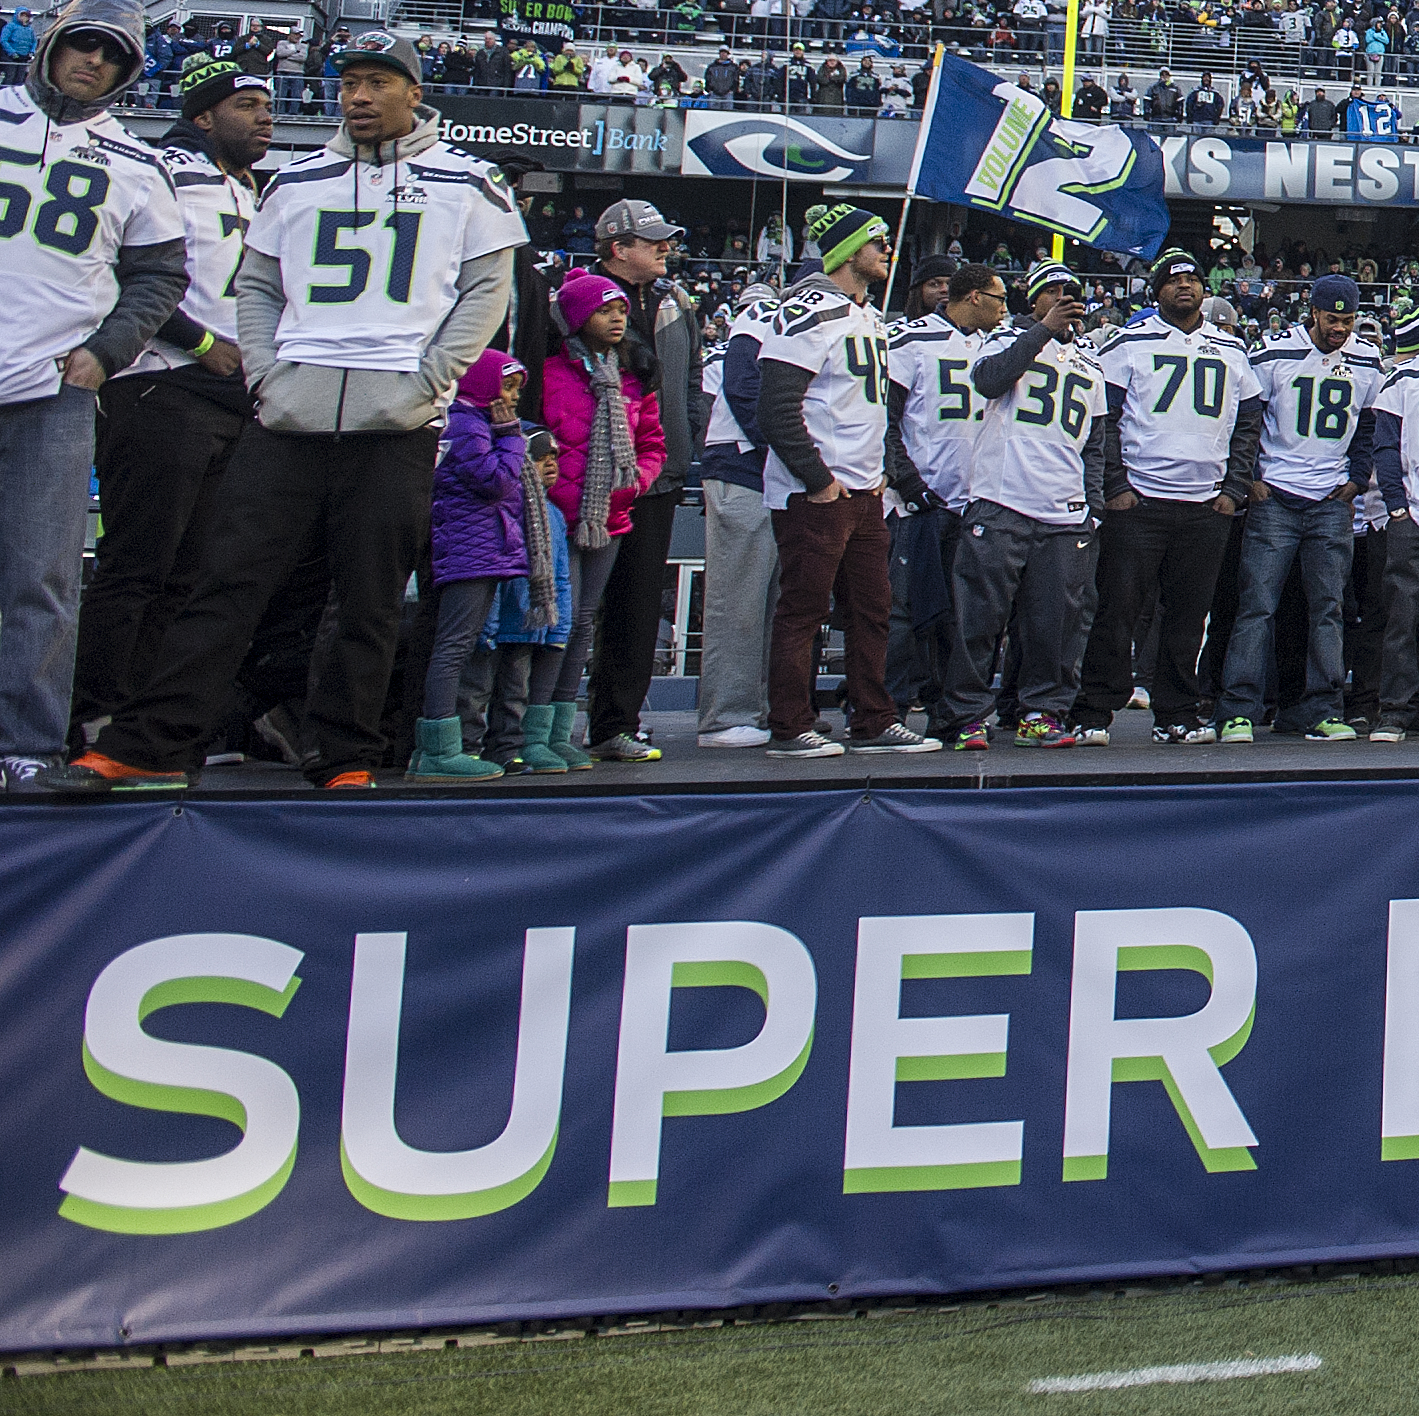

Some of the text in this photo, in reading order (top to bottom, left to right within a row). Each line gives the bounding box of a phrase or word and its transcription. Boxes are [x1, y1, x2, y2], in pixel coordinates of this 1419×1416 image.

[1022, 4, 1038, 15] 25
[213, 44, 233, 58] 12
[607, 128, 669, 153] Bank
[975, 97, 1037, 192] VOLUME
[1357, 103, 1393, 136] 12
[965, 82, 1137, 242] 12
[305, 207, 425, 306] 51
[937, 358, 986, 422] 5
[1013, 359, 1095, 441] 36
[1151, 353, 1228, 420] 70
[1291, 374, 1353, 441] 18
[57, 906, 1260, 1235] SUPER
